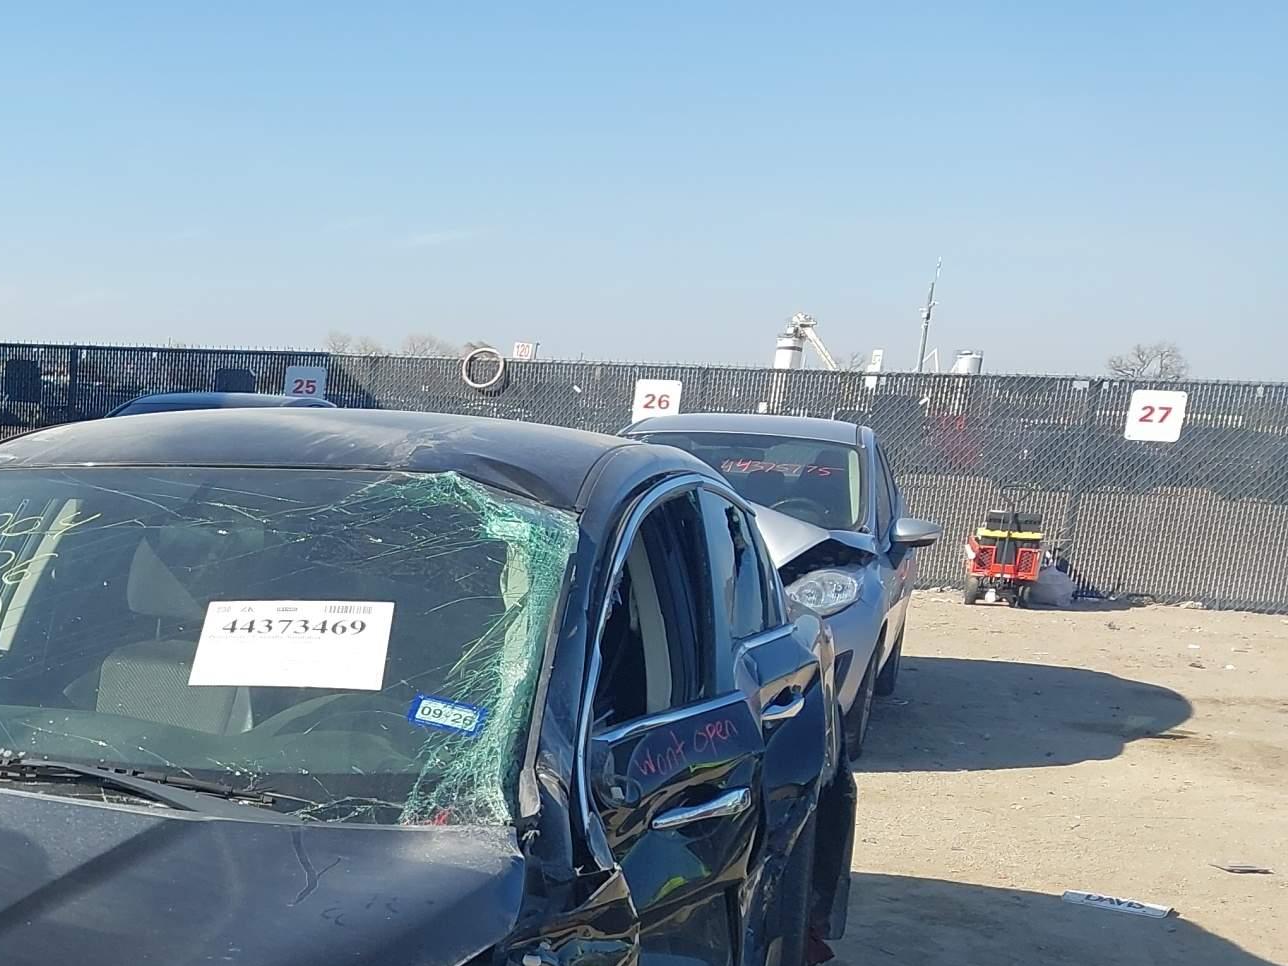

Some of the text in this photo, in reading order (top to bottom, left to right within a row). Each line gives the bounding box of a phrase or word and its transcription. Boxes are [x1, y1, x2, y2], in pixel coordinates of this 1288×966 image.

[292, 378, 317, 395] 25
[643, 393, 670, 410] 26
[1138, 405, 1173, 423] 27
[221, 618, 367, 636] 44373469
